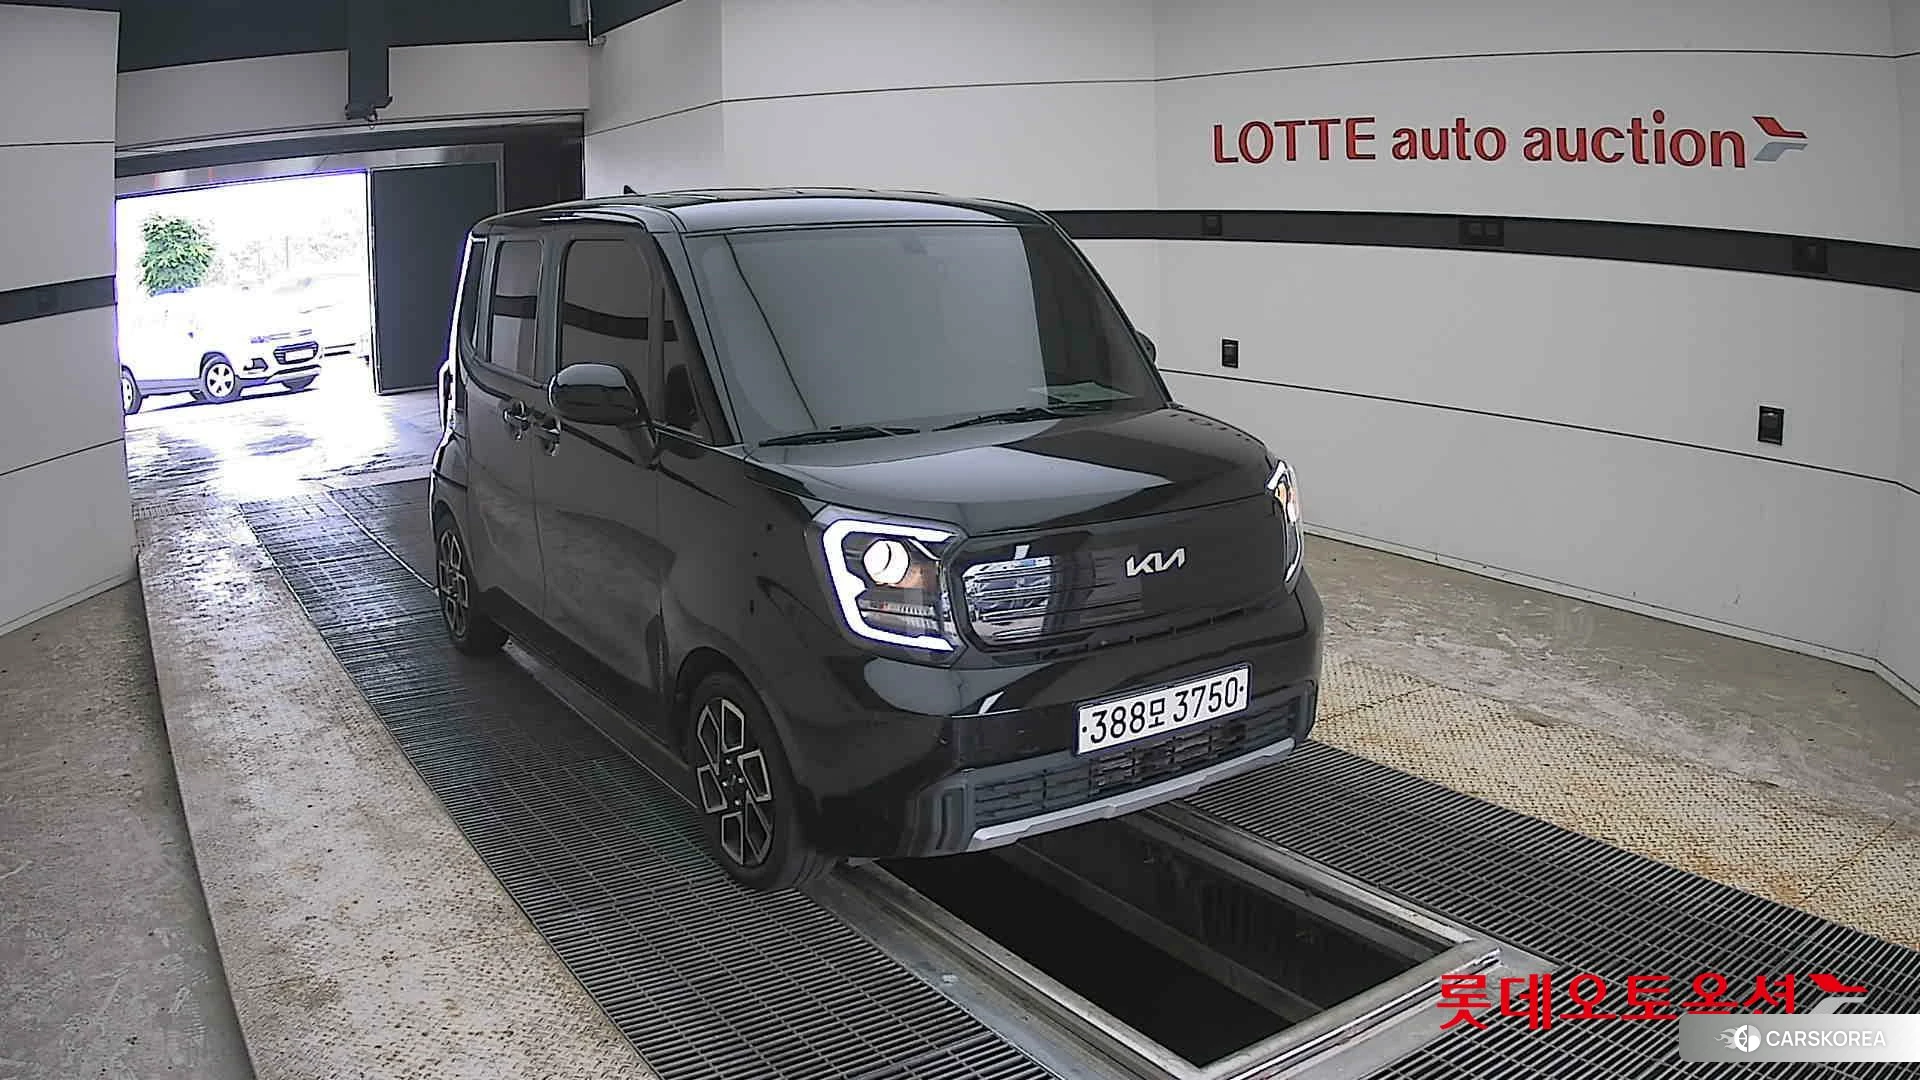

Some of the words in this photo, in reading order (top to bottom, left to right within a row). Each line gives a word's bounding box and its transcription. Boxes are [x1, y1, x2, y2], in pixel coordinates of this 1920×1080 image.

[1214, 117, 1376, 164] LOTTE
[1391, 118, 1507, 162] auto
[1522, 110, 1746, 169] auction
[1126, 548, 1185, 577] KIA
[1090, 697, 1166, 744] 388모
[1173, 676, 1238, 723] 3750
